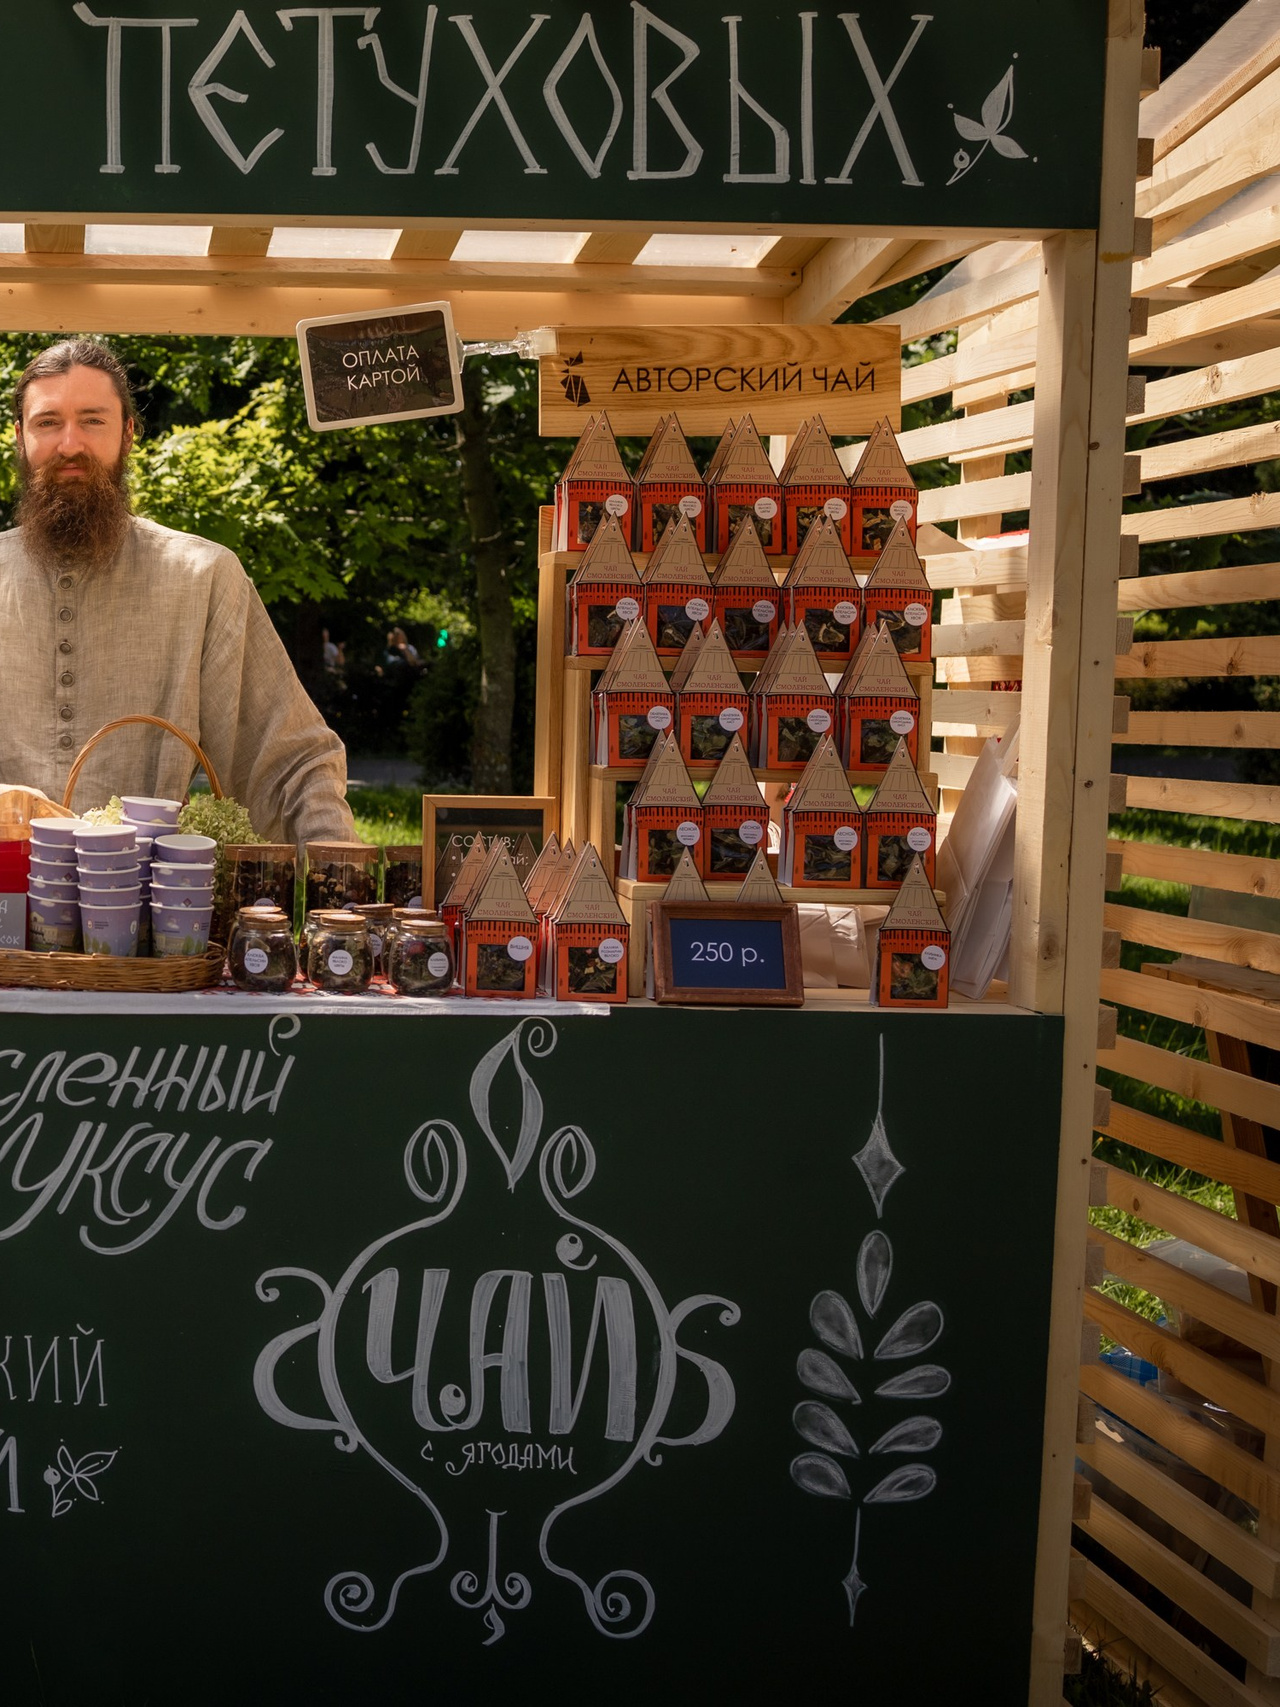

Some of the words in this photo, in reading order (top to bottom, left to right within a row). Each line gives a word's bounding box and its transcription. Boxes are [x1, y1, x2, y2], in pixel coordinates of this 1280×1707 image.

[72, 1, 934, 187] ПЕТУХОВЫХ
[342, 345, 420, 368] ОПЛАТА
[346, 363, 420, 391] КАРТОЙ
[612, 361, 802, 393] АВТОРСКИЙ
[812, 361, 876, 393] ЧАЙ
[577, 470, 624, 478] СМОЛЕНСКИЙ
[649, 472, 696, 480] СМОЛЕНСКИЙ
[725, 473, 772, 481] СМОЛЕНСКИЙ
[793, 474, 841, 482] СМОЛЕНСКИЙ
[860, 475, 908, 483] СМОЛЕНСКИЙ
[603, 564, 618, 572] ЧАЙ
[674, 565, 689, 573] ЧАЙ
[739, 567, 754, 575] ЧАЙ
[586, 572, 634, 580] СМОЛЕНСКИЙ
[656, 572, 705, 581] СМОЛЕНСКИЙ
[722, 575, 771, 583] СМОЛЕНСКИЙ
[803, 575, 852, 584] СМОЛЕНСКИЙ
[874, 577, 923, 585] СМОЛЕНСКИЙ
[876, 677, 892, 685] ЧАЙ
[775, 683, 824, 691] СМОЛЕНСКИЙ
[858, 685, 909, 693] СМОЛЕНСКИЙ
[645, 795, 694, 803] СМОЛЕНСКИЙ
[708, 794, 758, 802] СМОЛЕНСКИЙ
[803, 800, 852, 808] СМОЛЕНСКИЙ
[875, 801, 925, 809] СМОЛЕНСКИЙ
[495, 901, 511, 909] ЧАЙ
[477, 909, 529, 917] СМОЛЕНСКИЙ
[566, 911, 618, 919] СМОЛЕНСКИЙ
[889, 917, 940, 926] СМОЛЕНСКИЙ
[690, 941, 734, 962] 250
[741, 946, 765, 967] р.
[361, 1233, 638, 1442] ЧАЙ
